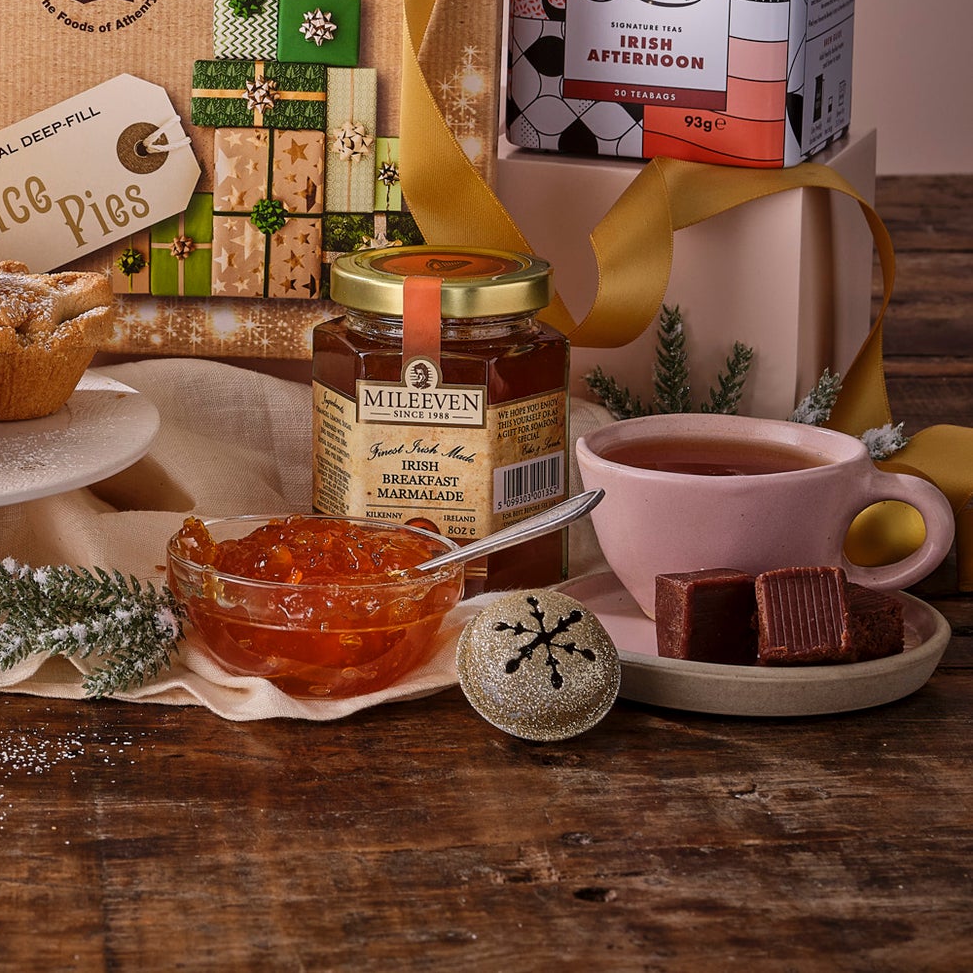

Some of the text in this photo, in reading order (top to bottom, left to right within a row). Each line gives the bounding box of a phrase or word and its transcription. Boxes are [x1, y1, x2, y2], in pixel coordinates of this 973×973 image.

[57, 11, 94, 33] Foods
[98, 22, 111, 33] of
[611, 22, 683, 33] SIGNATURE TEAS
[620, 35, 672, 51] IRISH
[587, 49, 704, 70] AFTERNOON
[614, 89, 676, 101] 30 TEABAGS
[20, 107, 101, 148] DEEP-FILL
[55, 184, 150, 248] Pies
[363, 389, 480, 411] MILEEVEN
[393, 410, 450, 420] SINCE 1988
[498, 398, 559, 419] WE HOPE YOU ENJOY
[498, 408, 559, 430] THIS YOURSELF OR AS
[503, 428, 517, 438] GIFT
[518, 425, 530, 434] FOR
[517, 431, 540, 444] SPECIAL
[367, 441, 405, 461] Finest
[405, 438, 440, 454] Irish
[441, 445, 477, 464] Made
[401, 460, 439, 471] IRISH
[382, 473, 459, 487] BREAKFAST
[377, 488, 464, 502] MARMALADE
[498, 502, 502, 510] 5
[366, 511, 476, 523] KILKENNY IRELAND
